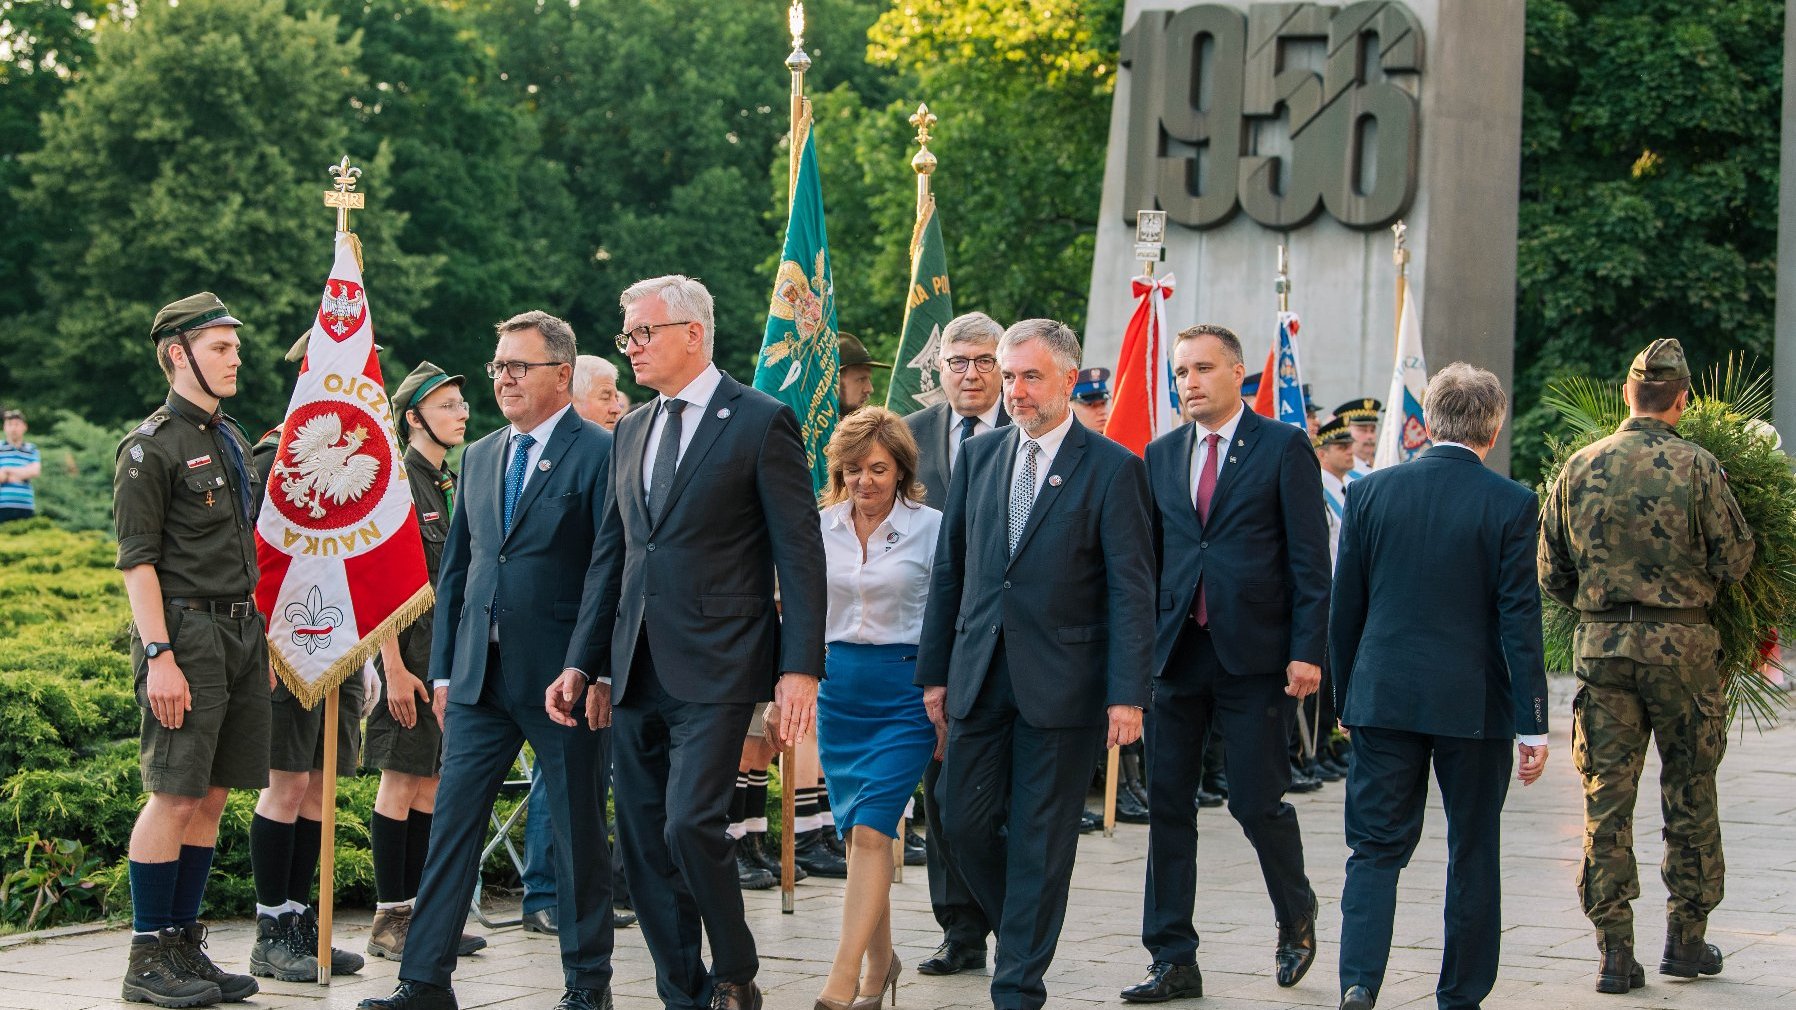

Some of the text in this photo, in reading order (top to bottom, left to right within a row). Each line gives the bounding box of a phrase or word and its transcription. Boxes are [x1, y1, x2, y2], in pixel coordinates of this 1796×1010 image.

[1120, 0, 1424, 230] 1956
[326, 192, 361, 207] ZHR
[284, 520, 382, 556] NAUKA
